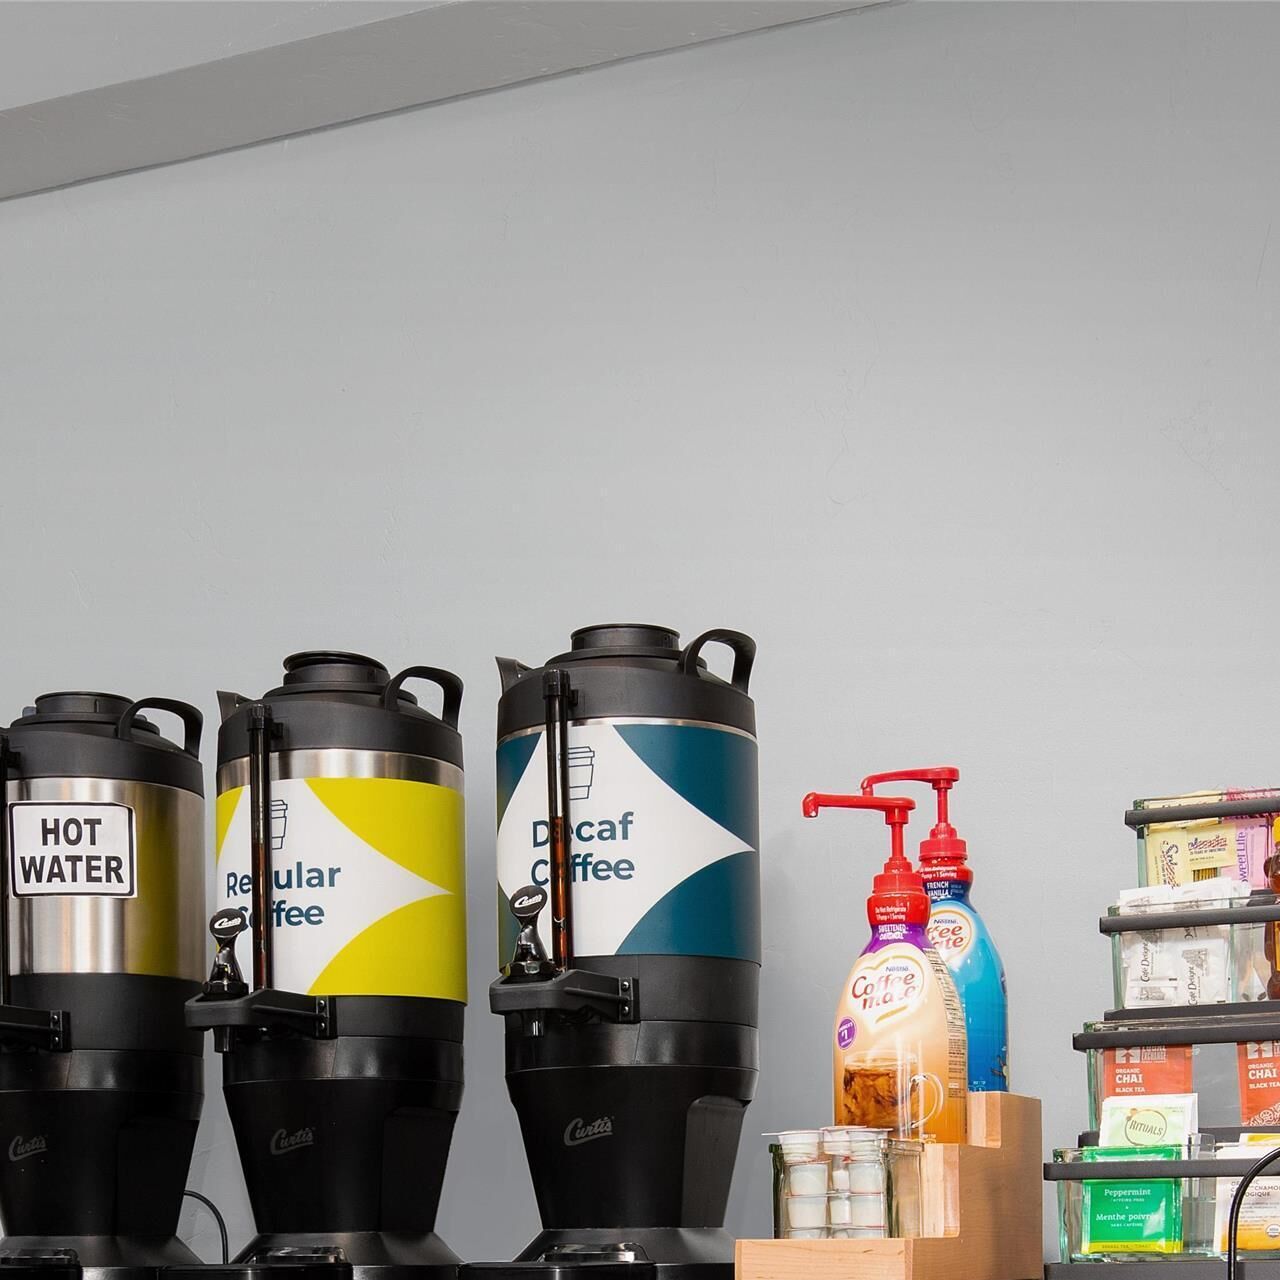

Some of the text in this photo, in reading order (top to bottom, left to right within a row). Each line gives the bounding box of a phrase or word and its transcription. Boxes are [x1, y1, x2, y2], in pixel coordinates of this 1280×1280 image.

[40, 817, 102, 847] HOT
[532, 811, 635, 848] Dcaf
[19, 855, 124, 884] WATER
[227, 861, 341, 898] Reular
[531, 852, 635, 886] Cffee
[927, 881, 949, 889] FRENCH
[928, 889, 949, 897] VANILLA
[851, 973, 915, 999] Coffee
[1115, 1074, 1143, 1084] CHAI
[1248, 1068, 1278, 1079] CHAI
[563, 1116, 613, 1146] Curtis
[1129, 1119, 1164, 1136] RITUALS
[269, 1127, 315, 1155] Curtis
[1104, 1188, 1151, 1198] Peppermint
[1095, 1213, 1126, 1221] Menthe
